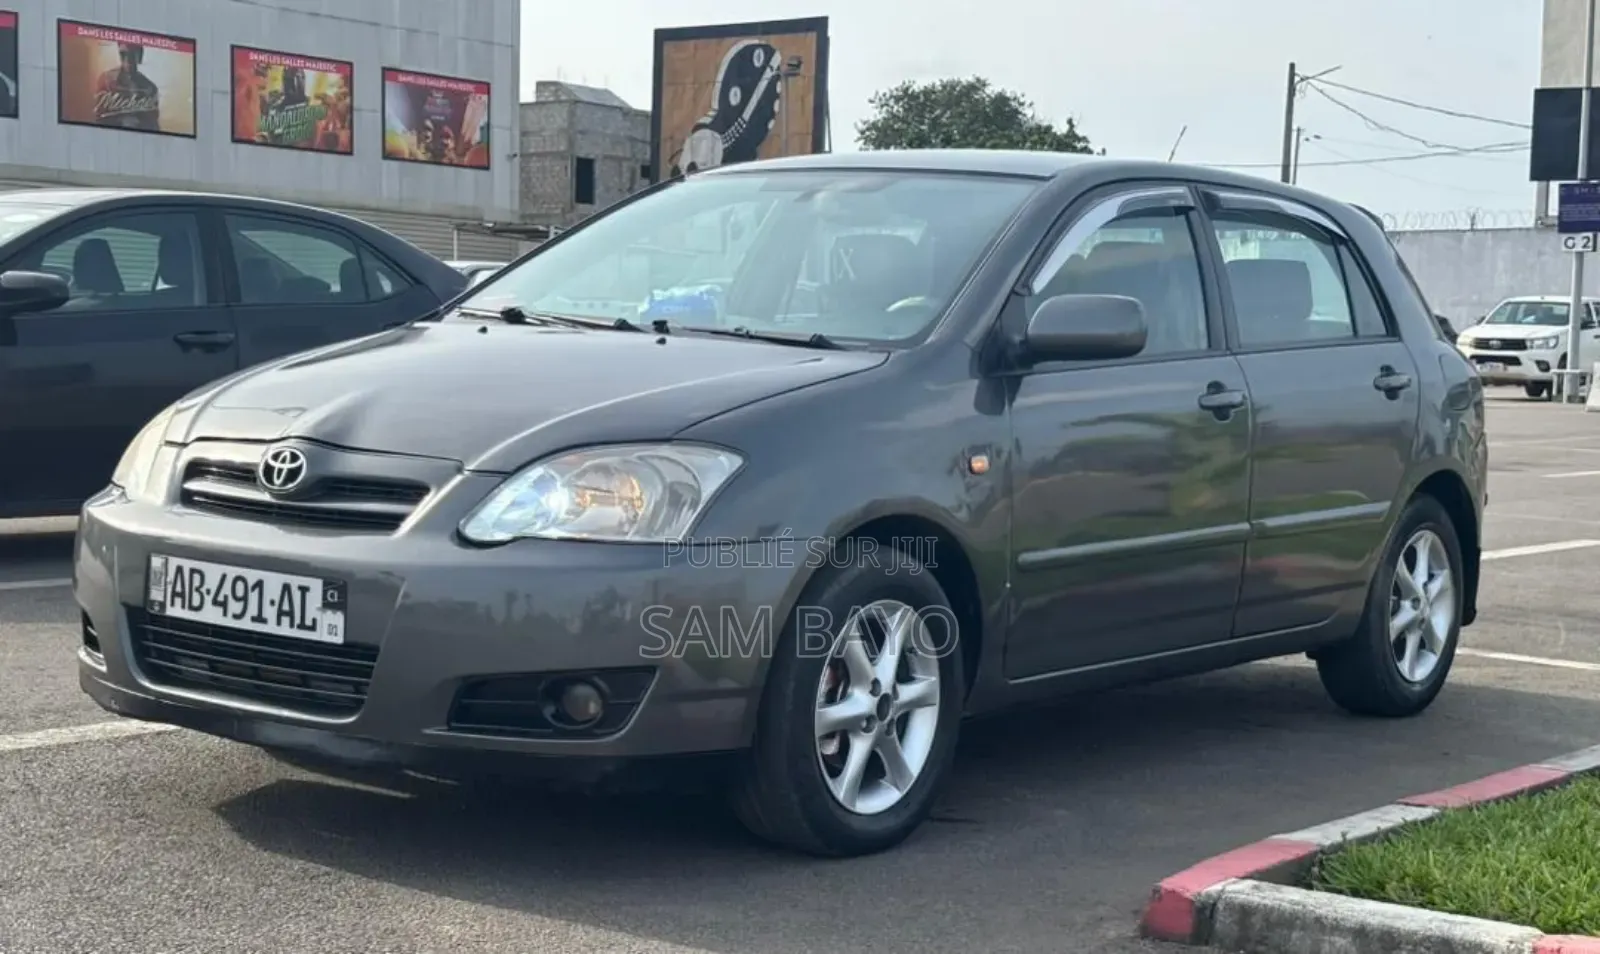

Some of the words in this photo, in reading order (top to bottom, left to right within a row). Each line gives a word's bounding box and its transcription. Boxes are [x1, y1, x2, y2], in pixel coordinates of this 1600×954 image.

[77, 26, 99, 38] DANS
[100, 29, 114, 39] LES
[114, 31, 141, 44] SALLES
